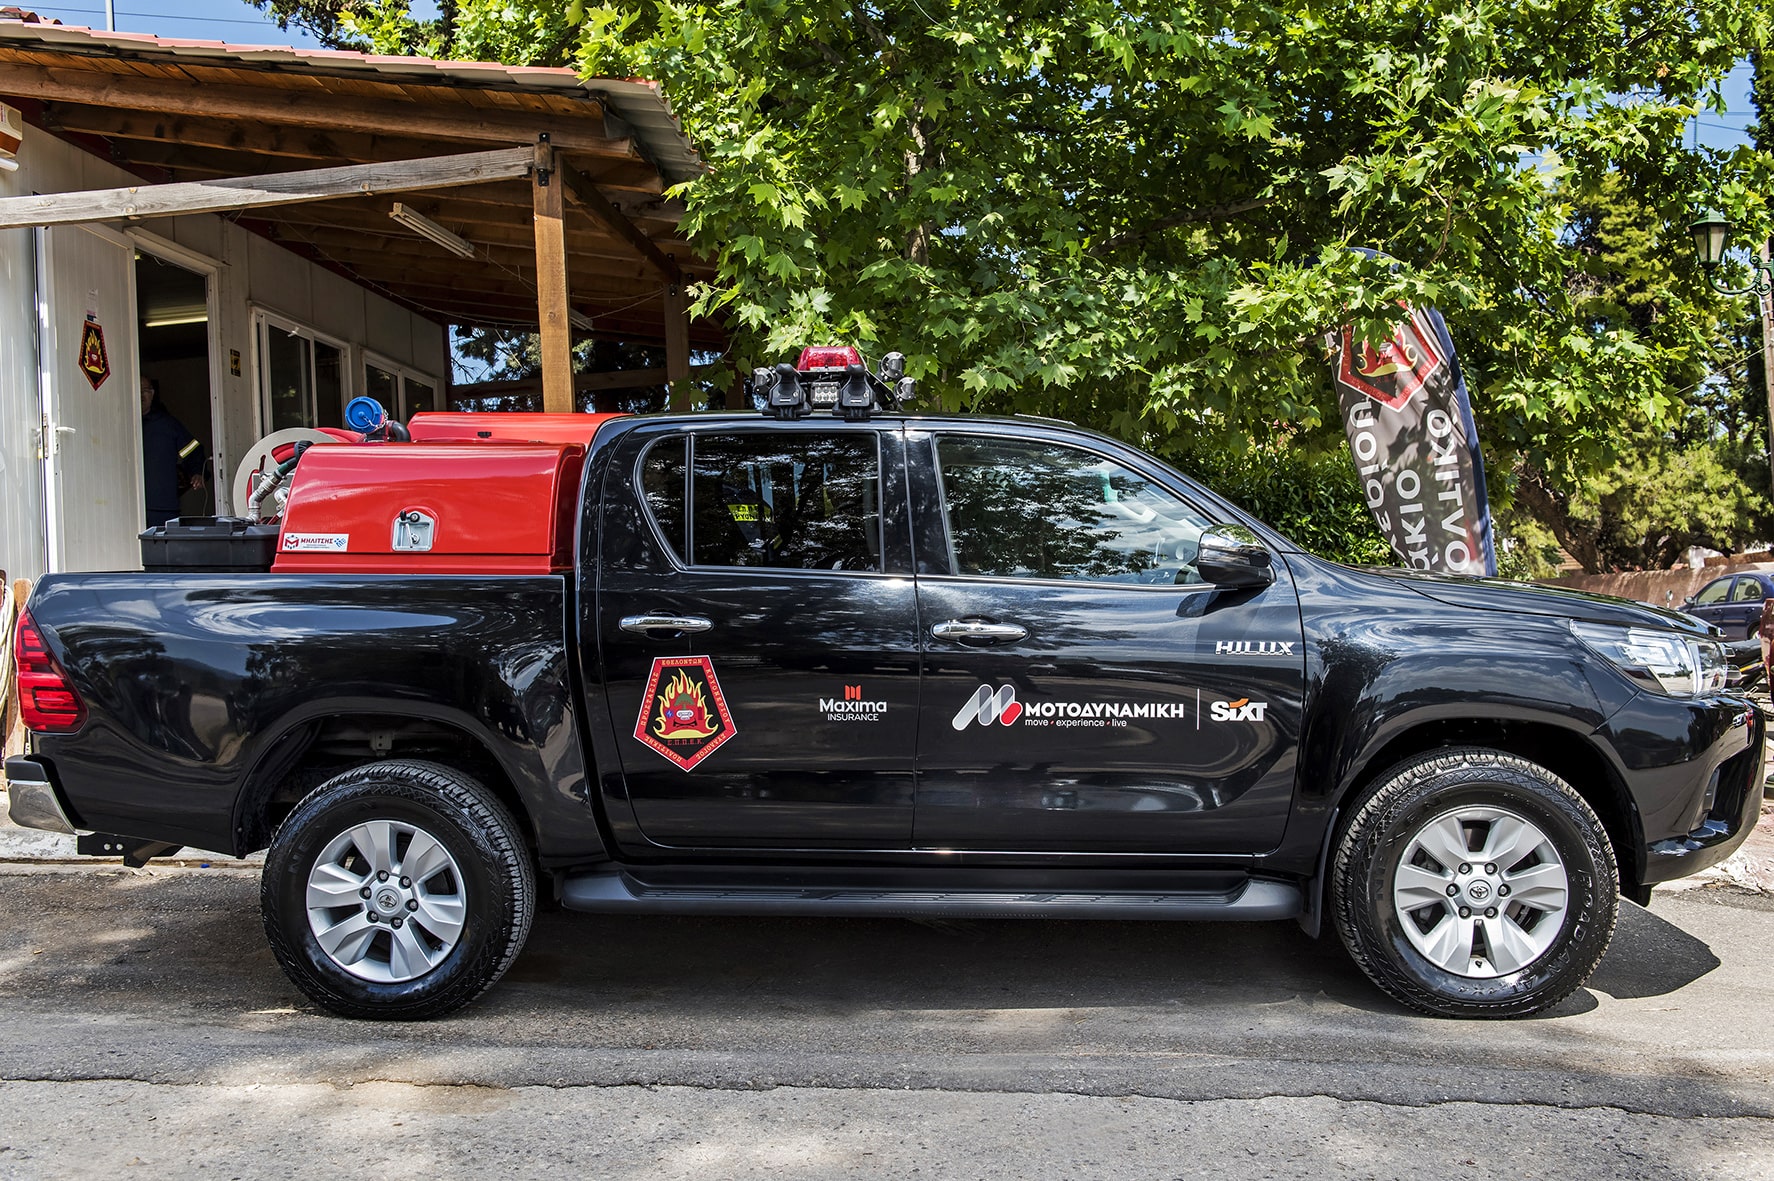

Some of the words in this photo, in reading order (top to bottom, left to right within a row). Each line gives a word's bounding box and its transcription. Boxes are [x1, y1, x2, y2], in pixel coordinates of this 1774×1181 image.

[1215, 640, 1295, 656] HILUX
[819, 698, 887, 713] Maxima
[1025, 702, 1184, 718] ΜΟΤΟΔΥΝΑΜΙΚΗ
[827, 713, 879, 722] INSURANCE
[1025, 719, 1049, 727] move
[1056, 718, 1105, 728] experience
[1111, 718, 1127, 727] live
